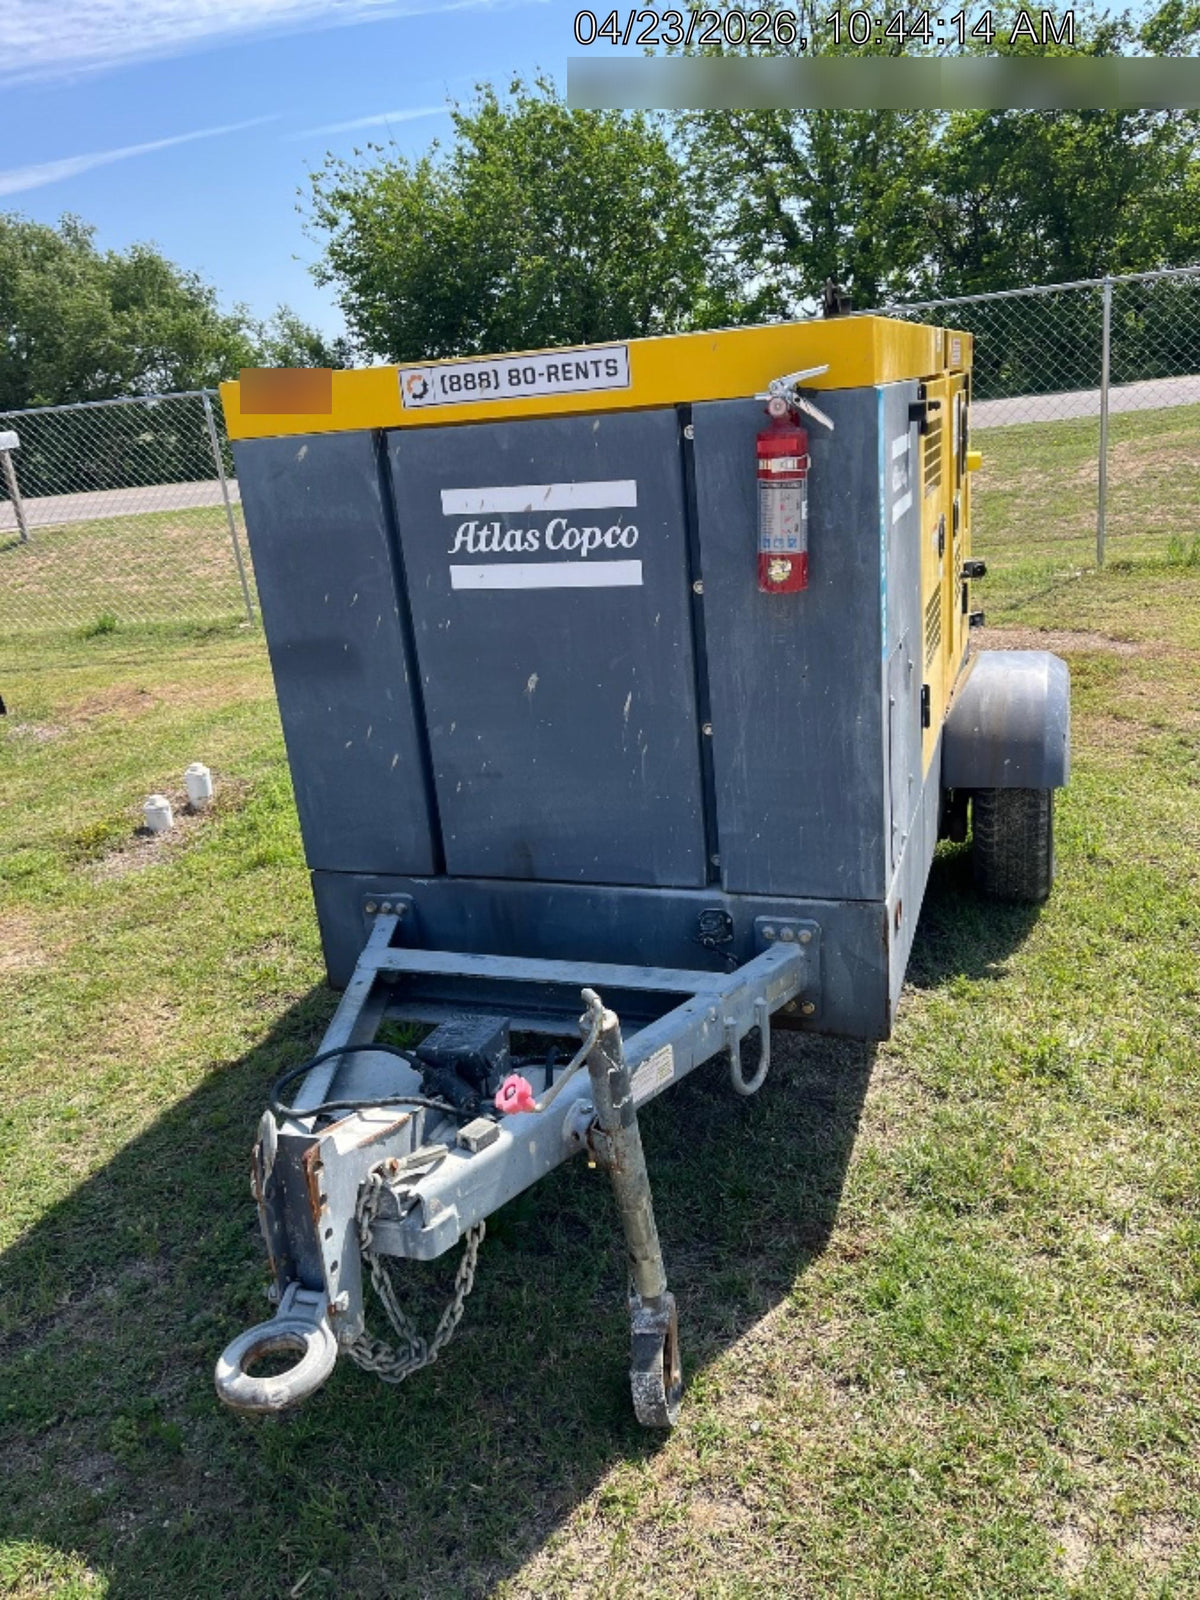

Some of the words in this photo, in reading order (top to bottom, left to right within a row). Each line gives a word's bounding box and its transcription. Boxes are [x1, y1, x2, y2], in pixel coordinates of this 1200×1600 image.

[440, 369, 500, 395] (888)
[508, 358, 618, 386] 80-RENTS
[447, 519, 540, 554] Atlas
[545, 517, 639, 557] Copco
